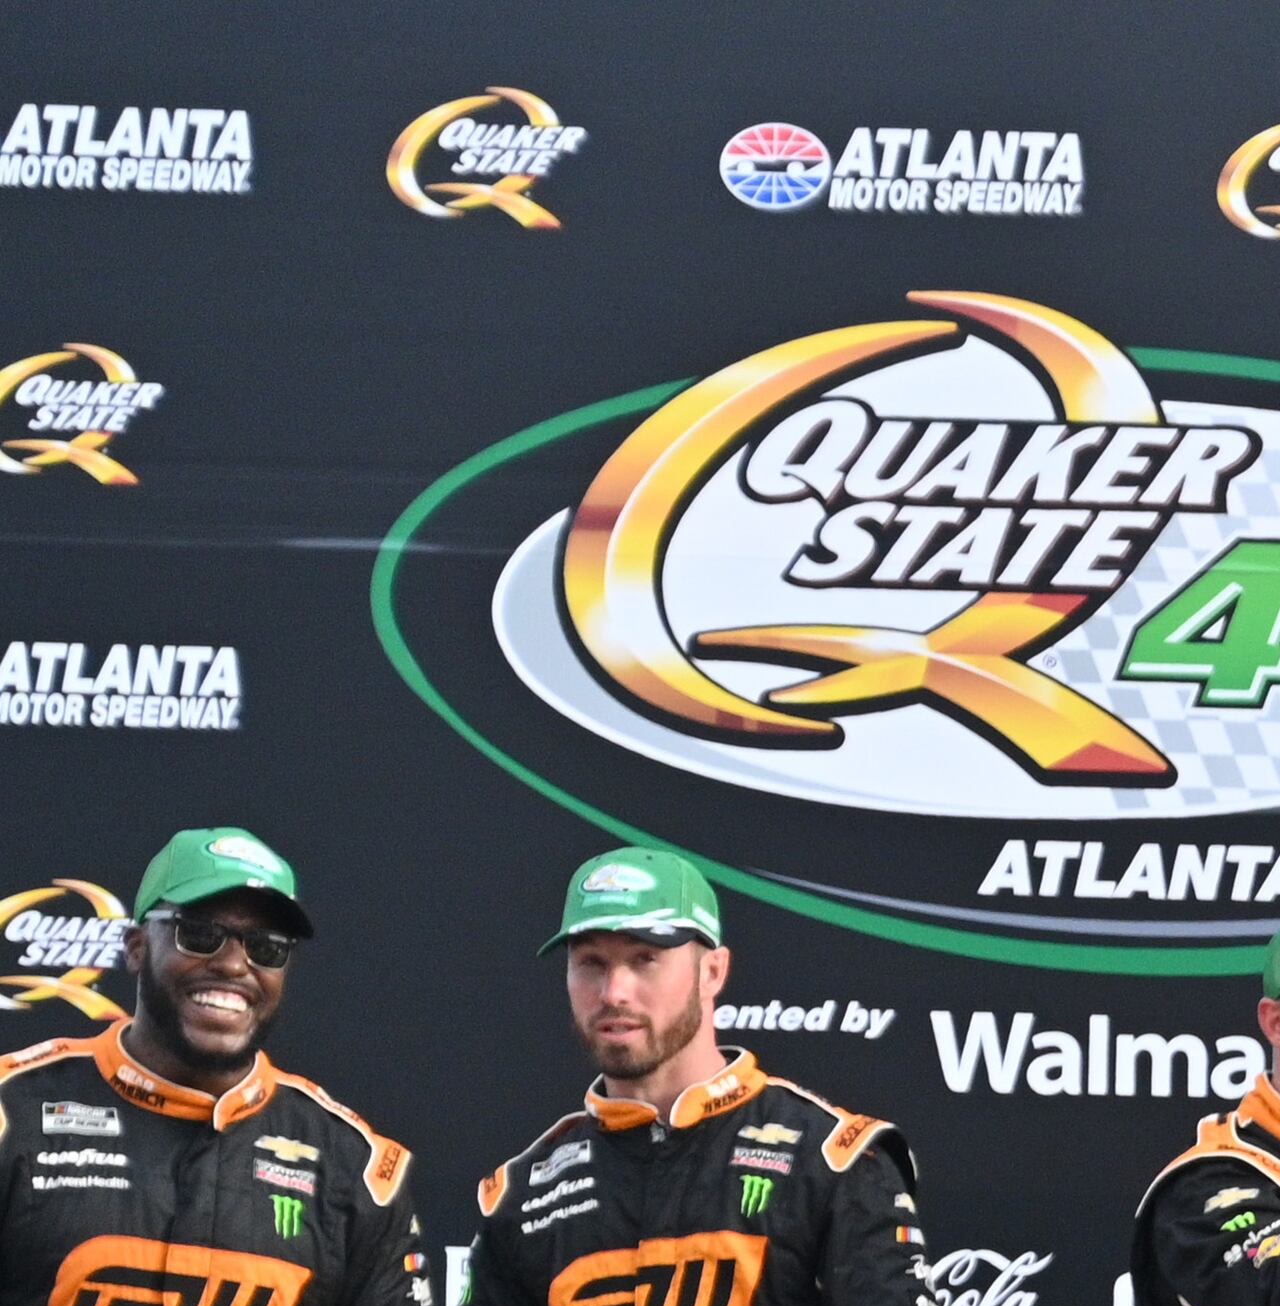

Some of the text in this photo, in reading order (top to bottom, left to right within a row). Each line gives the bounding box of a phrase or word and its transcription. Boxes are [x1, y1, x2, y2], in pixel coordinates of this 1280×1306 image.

[3, 103, 253, 160] ATLANTA
[437, 117, 588, 154] QUAKER
[0, 155, 250, 193] MOTOR SPEEDWAY
[451, 148, 556, 176] STATE
[834, 128, 1083, 183] ATLANTA
[829, 178, 1083, 216] MOTOR SPEEDWAY
[15, 373, 164, 410] QUAKER
[28, 403, 136, 433] STATE
[741, 398, 1260, 511] QUAKER
[783, 503, 1170, 588] STATE
[0, 642, 239, 698] ATLANTA
[90, 695, 239, 730] SPEEDWAY
[19, 941, 124, 969] STATE
[714, 998, 895, 1040] ented by
[930, 1010, 1267, 1099] Walma
